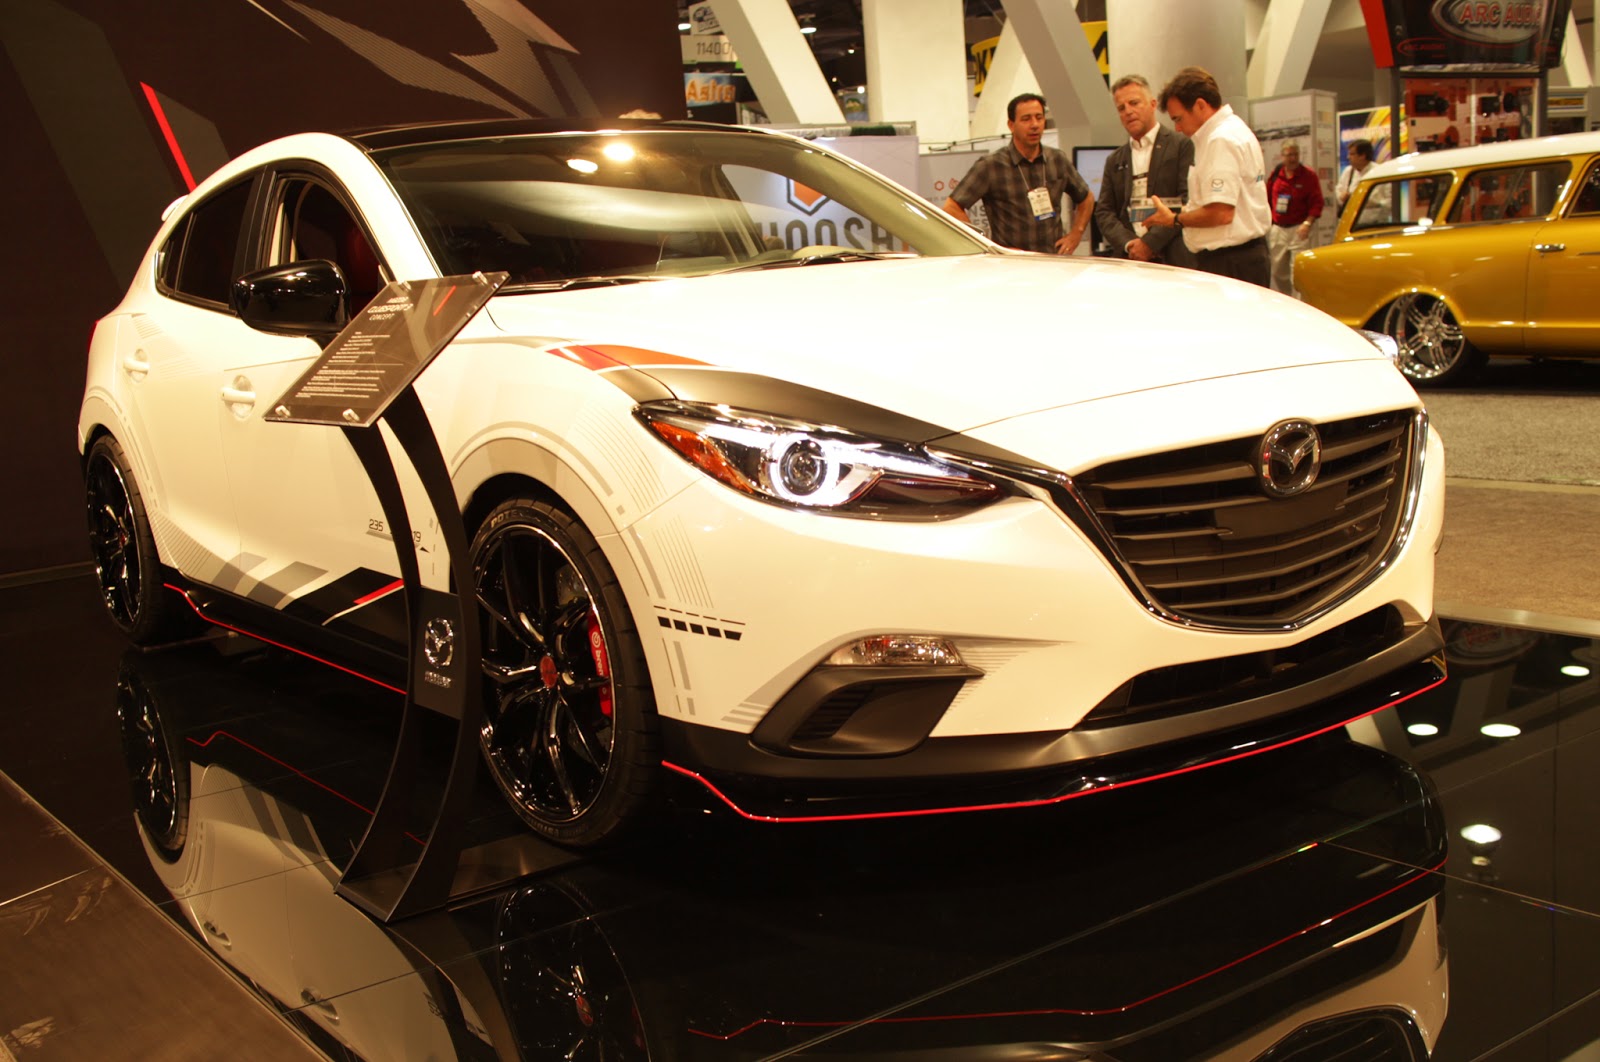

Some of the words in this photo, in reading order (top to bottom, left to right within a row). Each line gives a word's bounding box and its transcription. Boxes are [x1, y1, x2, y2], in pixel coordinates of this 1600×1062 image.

[1459, 2, 1501, 24] ARC
[1504, 3, 1542, 25] AUD
[368, 518, 384, 532] 235
